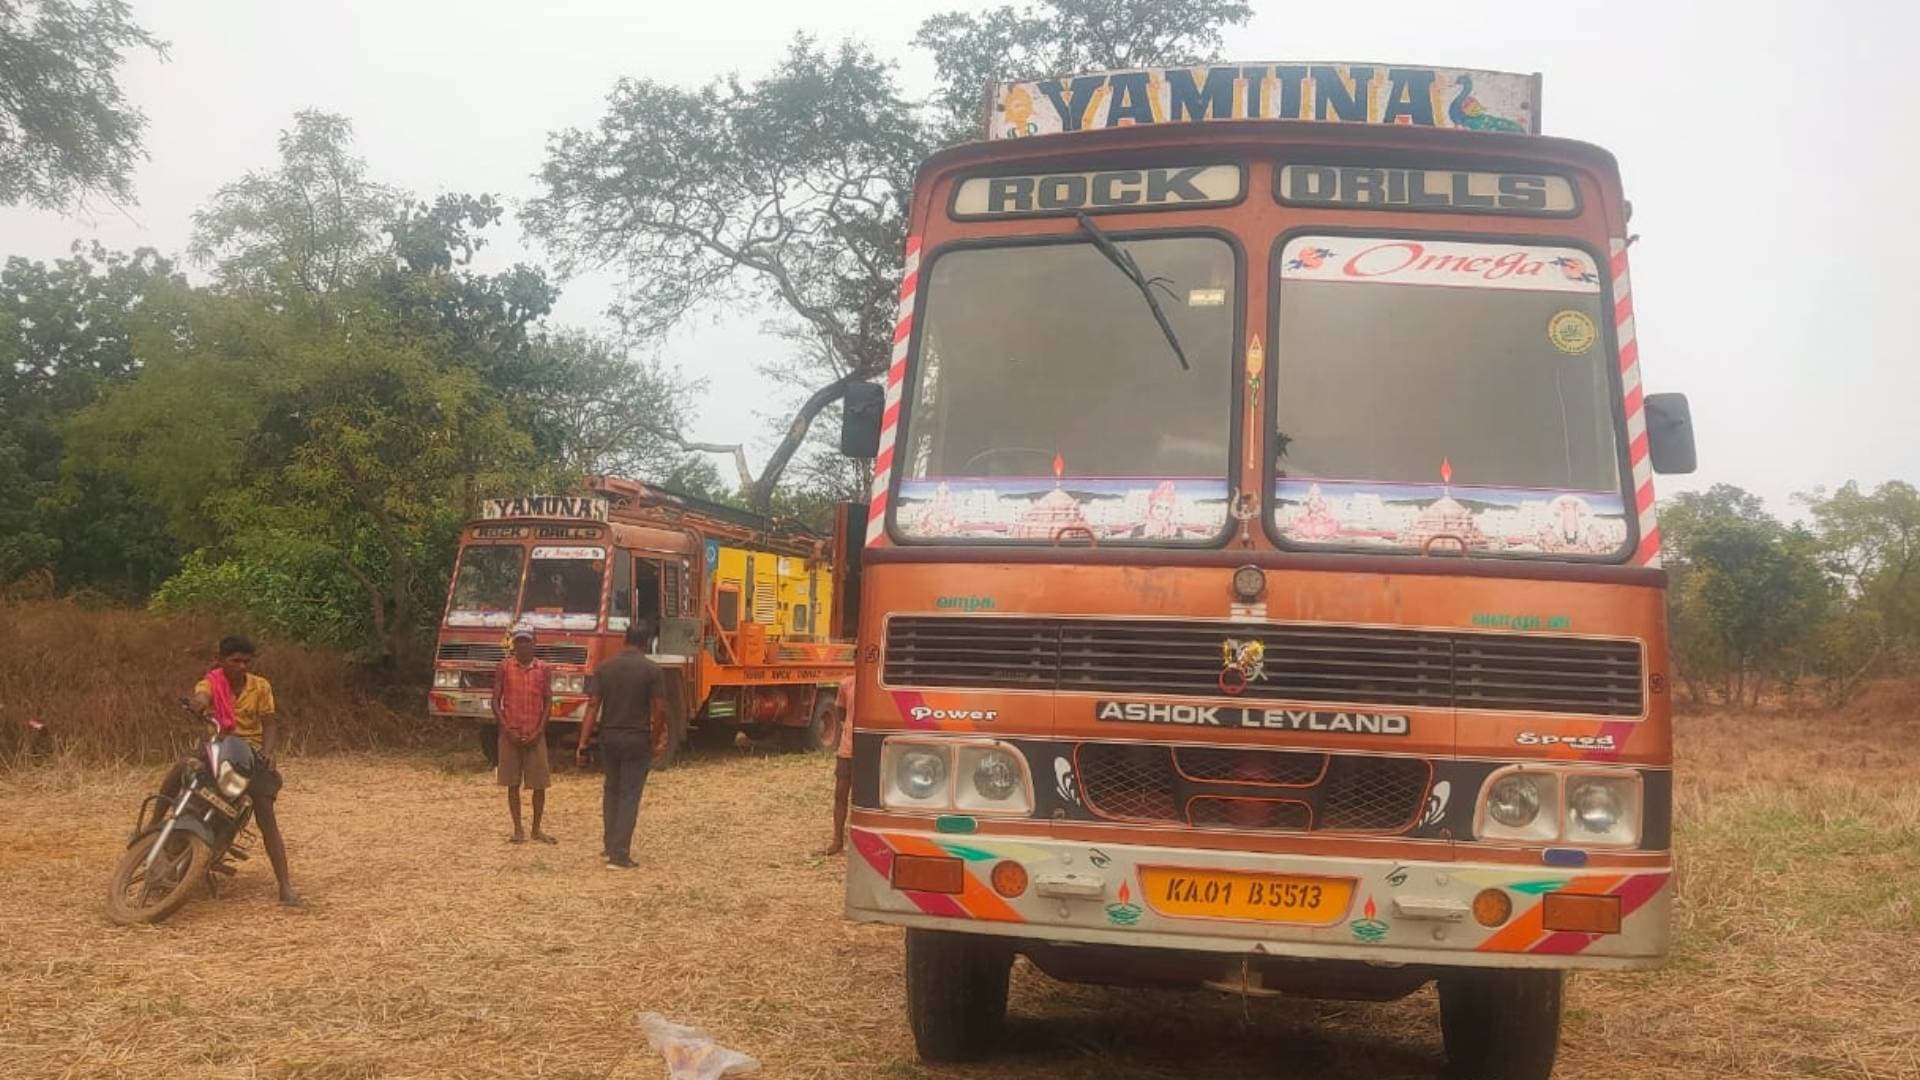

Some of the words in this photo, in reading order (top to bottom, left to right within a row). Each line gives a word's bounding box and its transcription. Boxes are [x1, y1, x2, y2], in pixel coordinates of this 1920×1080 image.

[988, 166, 1211, 212] ROCK
[1289, 165, 1547, 210] DRILLS
[1342, 242, 1545, 281] Omega
[494, 496, 592, 518] YAMUNA
[910, 706, 998, 721] Power
[1099, 701, 1220, 726] ASHOK
[1241, 707, 1408, 735] LEYLAND
